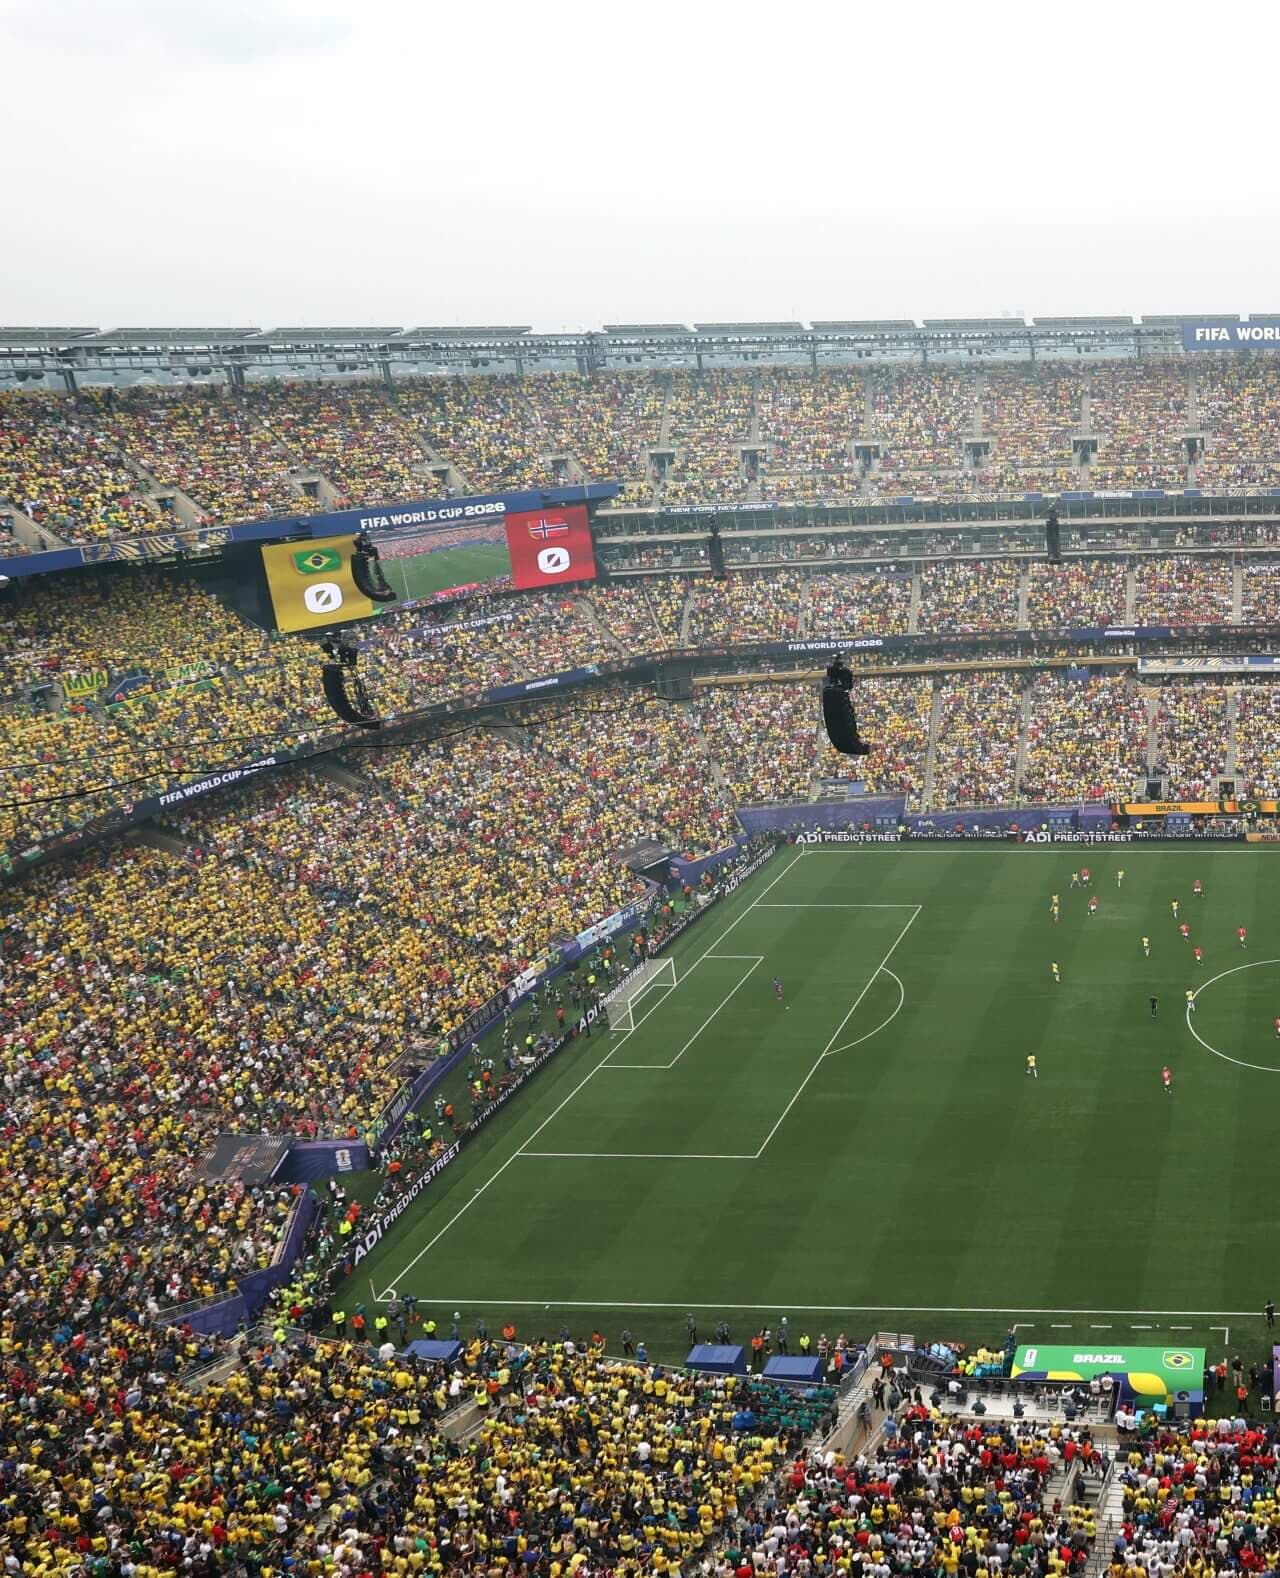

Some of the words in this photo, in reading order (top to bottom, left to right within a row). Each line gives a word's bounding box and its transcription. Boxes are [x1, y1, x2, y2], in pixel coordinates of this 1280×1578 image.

[1195, 327, 1230, 341] FIFA
[361, 517, 389, 529] FIFA
[390, 511, 437, 525] WORLD
[438, 507, 463, 519] CUP
[464, 502, 506, 516] 2026
[788, 643, 806, 651] FIFA
[854, 639, 883, 647] 2026
[179, 662, 207, 677] MVA
[66, 672, 106, 690] MVA
[159, 791, 184, 806] FIFA
[183, 777, 221, 797] WORLD
[221, 770, 242, 783] CUP
[1155, 804, 1183, 812] BRAZIL
[795, 834, 822, 844] ADI
[824, 834, 902, 843] PREDICTSTREET
[1024, 831, 1051, 843] ADI
[1054, 832, 1133, 843] PREDICTSTREET
[723, 877, 739, 897] ADI
[738, 846, 777, 883] PREDICTSTREET
[579, 1006, 600, 1033] ADI
[353, 1224, 383, 1266] ADI
[383, 1140, 461, 1229] PREDICTSTREET
[1073, 1353, 1126, 1364] BRAZIL
